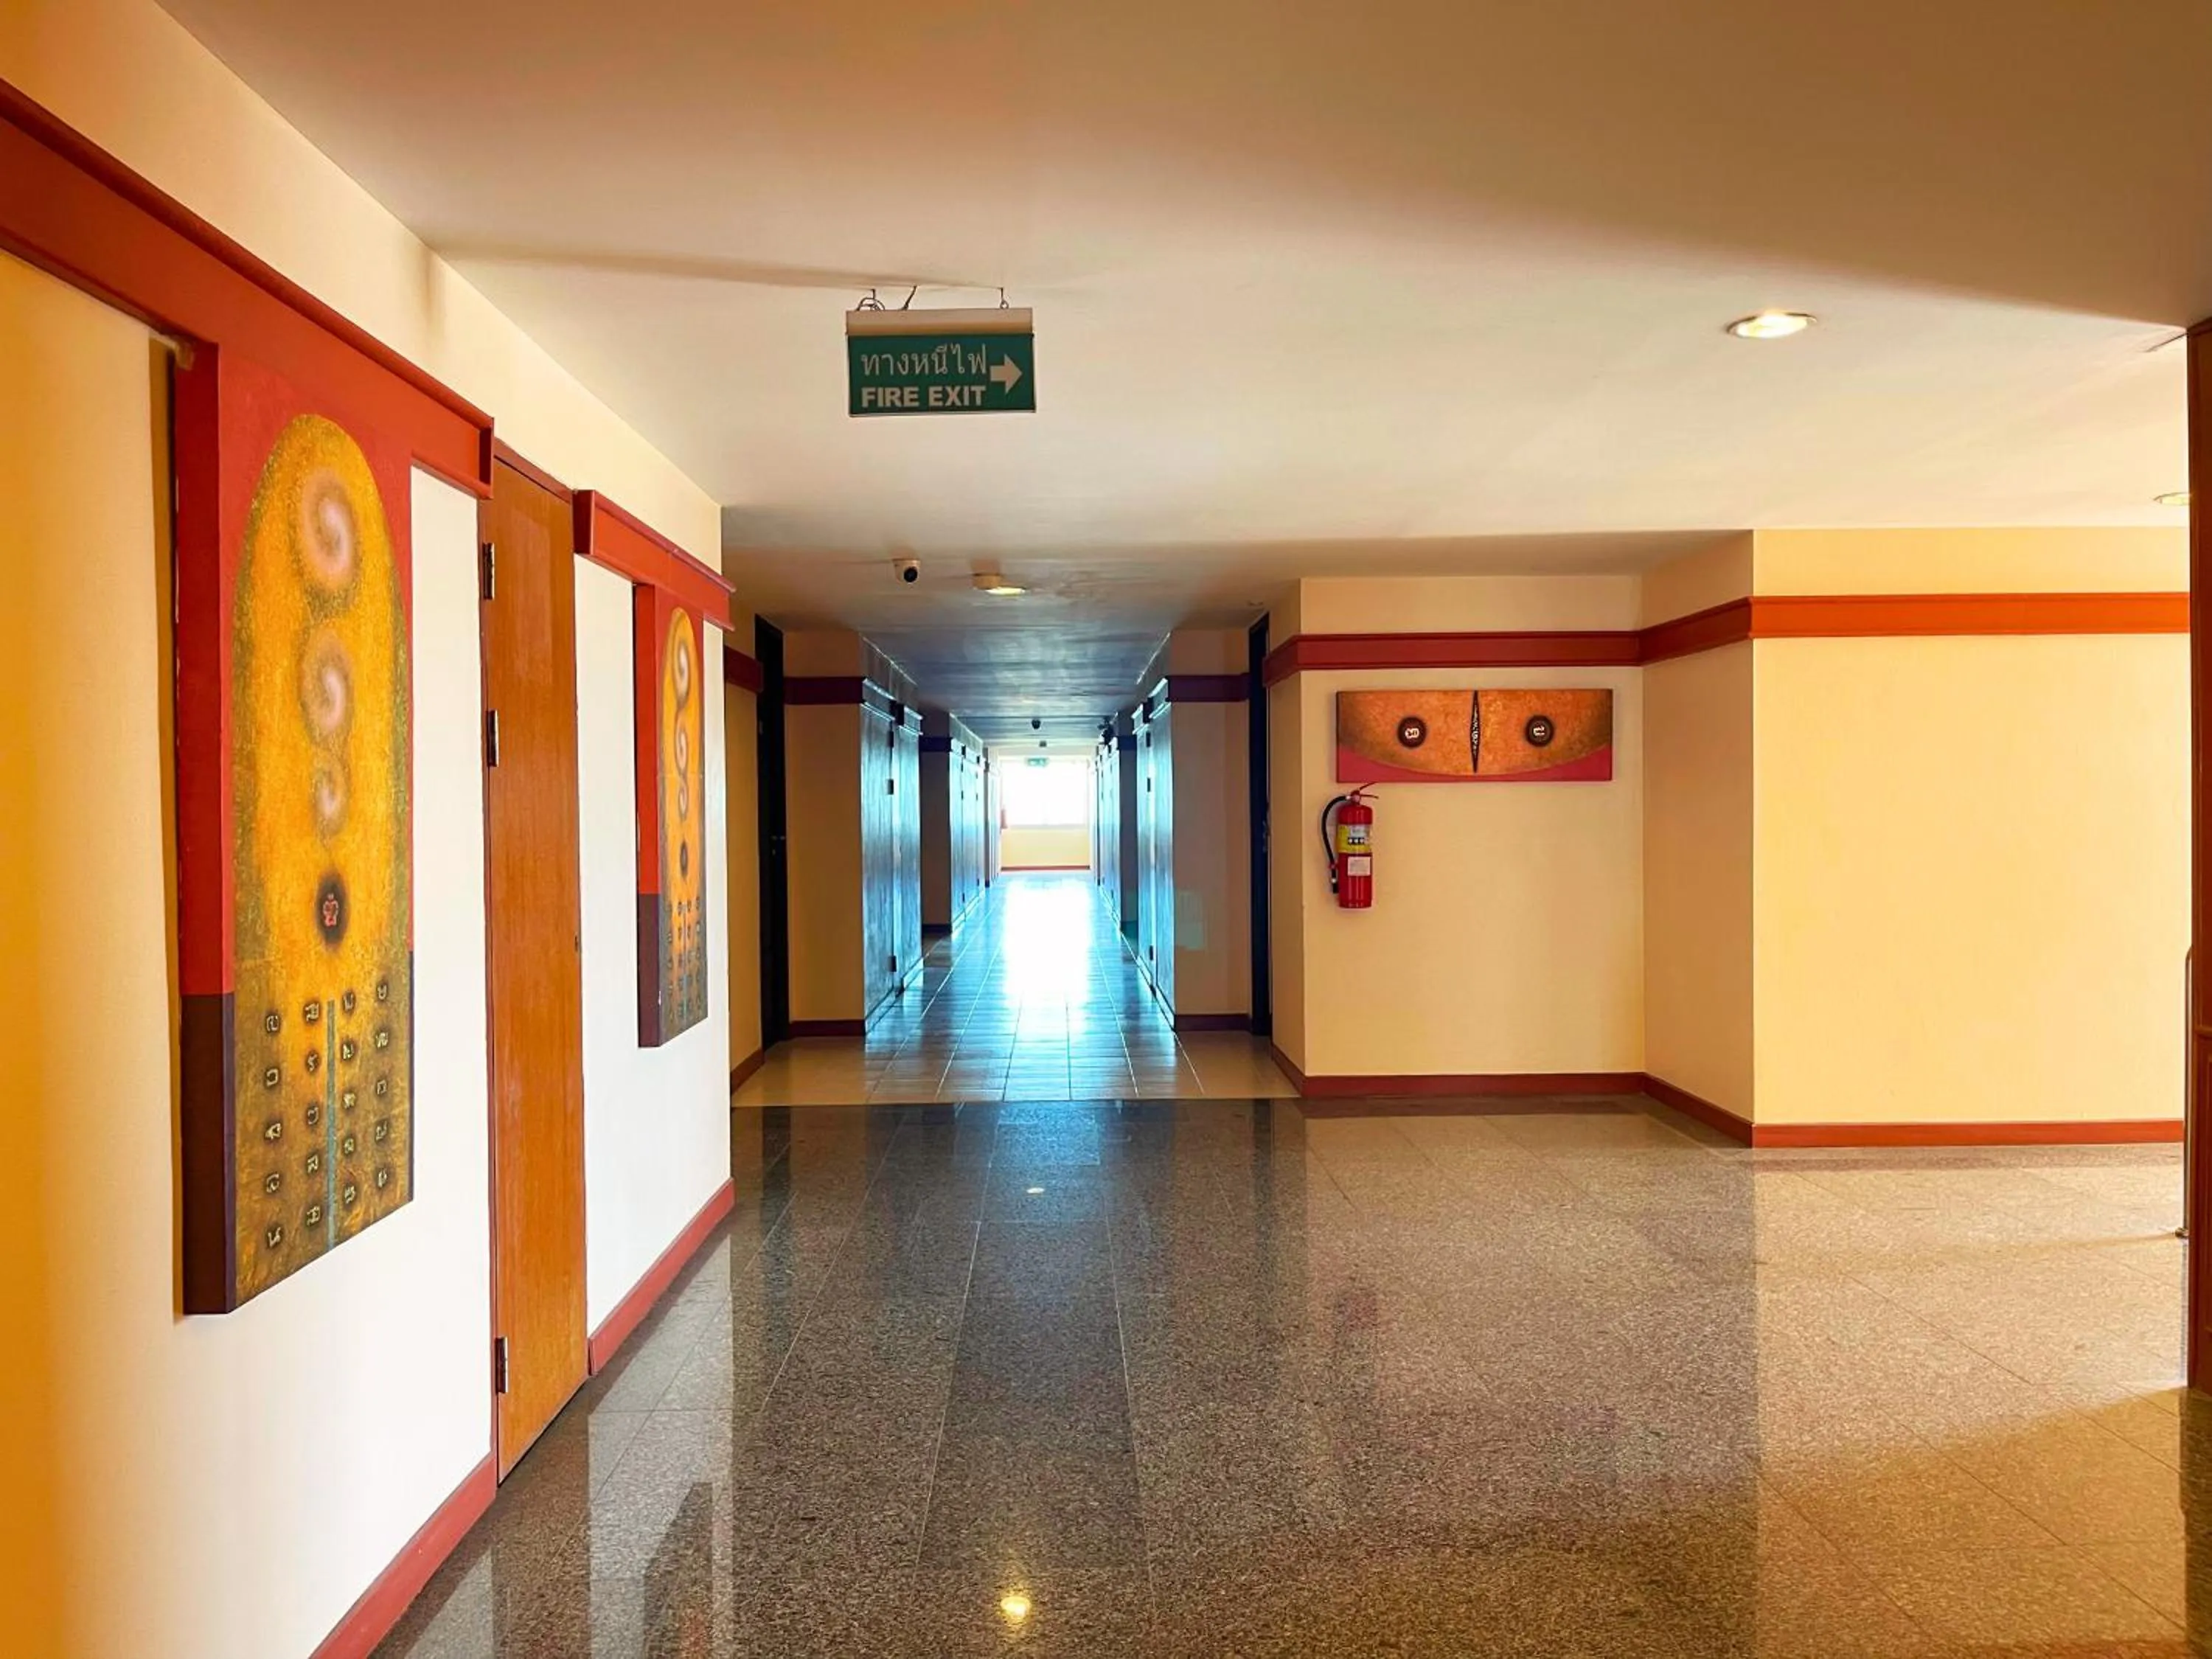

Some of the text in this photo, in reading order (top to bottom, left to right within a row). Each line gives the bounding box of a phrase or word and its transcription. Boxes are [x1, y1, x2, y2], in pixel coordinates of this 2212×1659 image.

[860, 342, 987, 376] ทางหนีไฟ
[861, 385, 987, 408] FIRE EXIT
